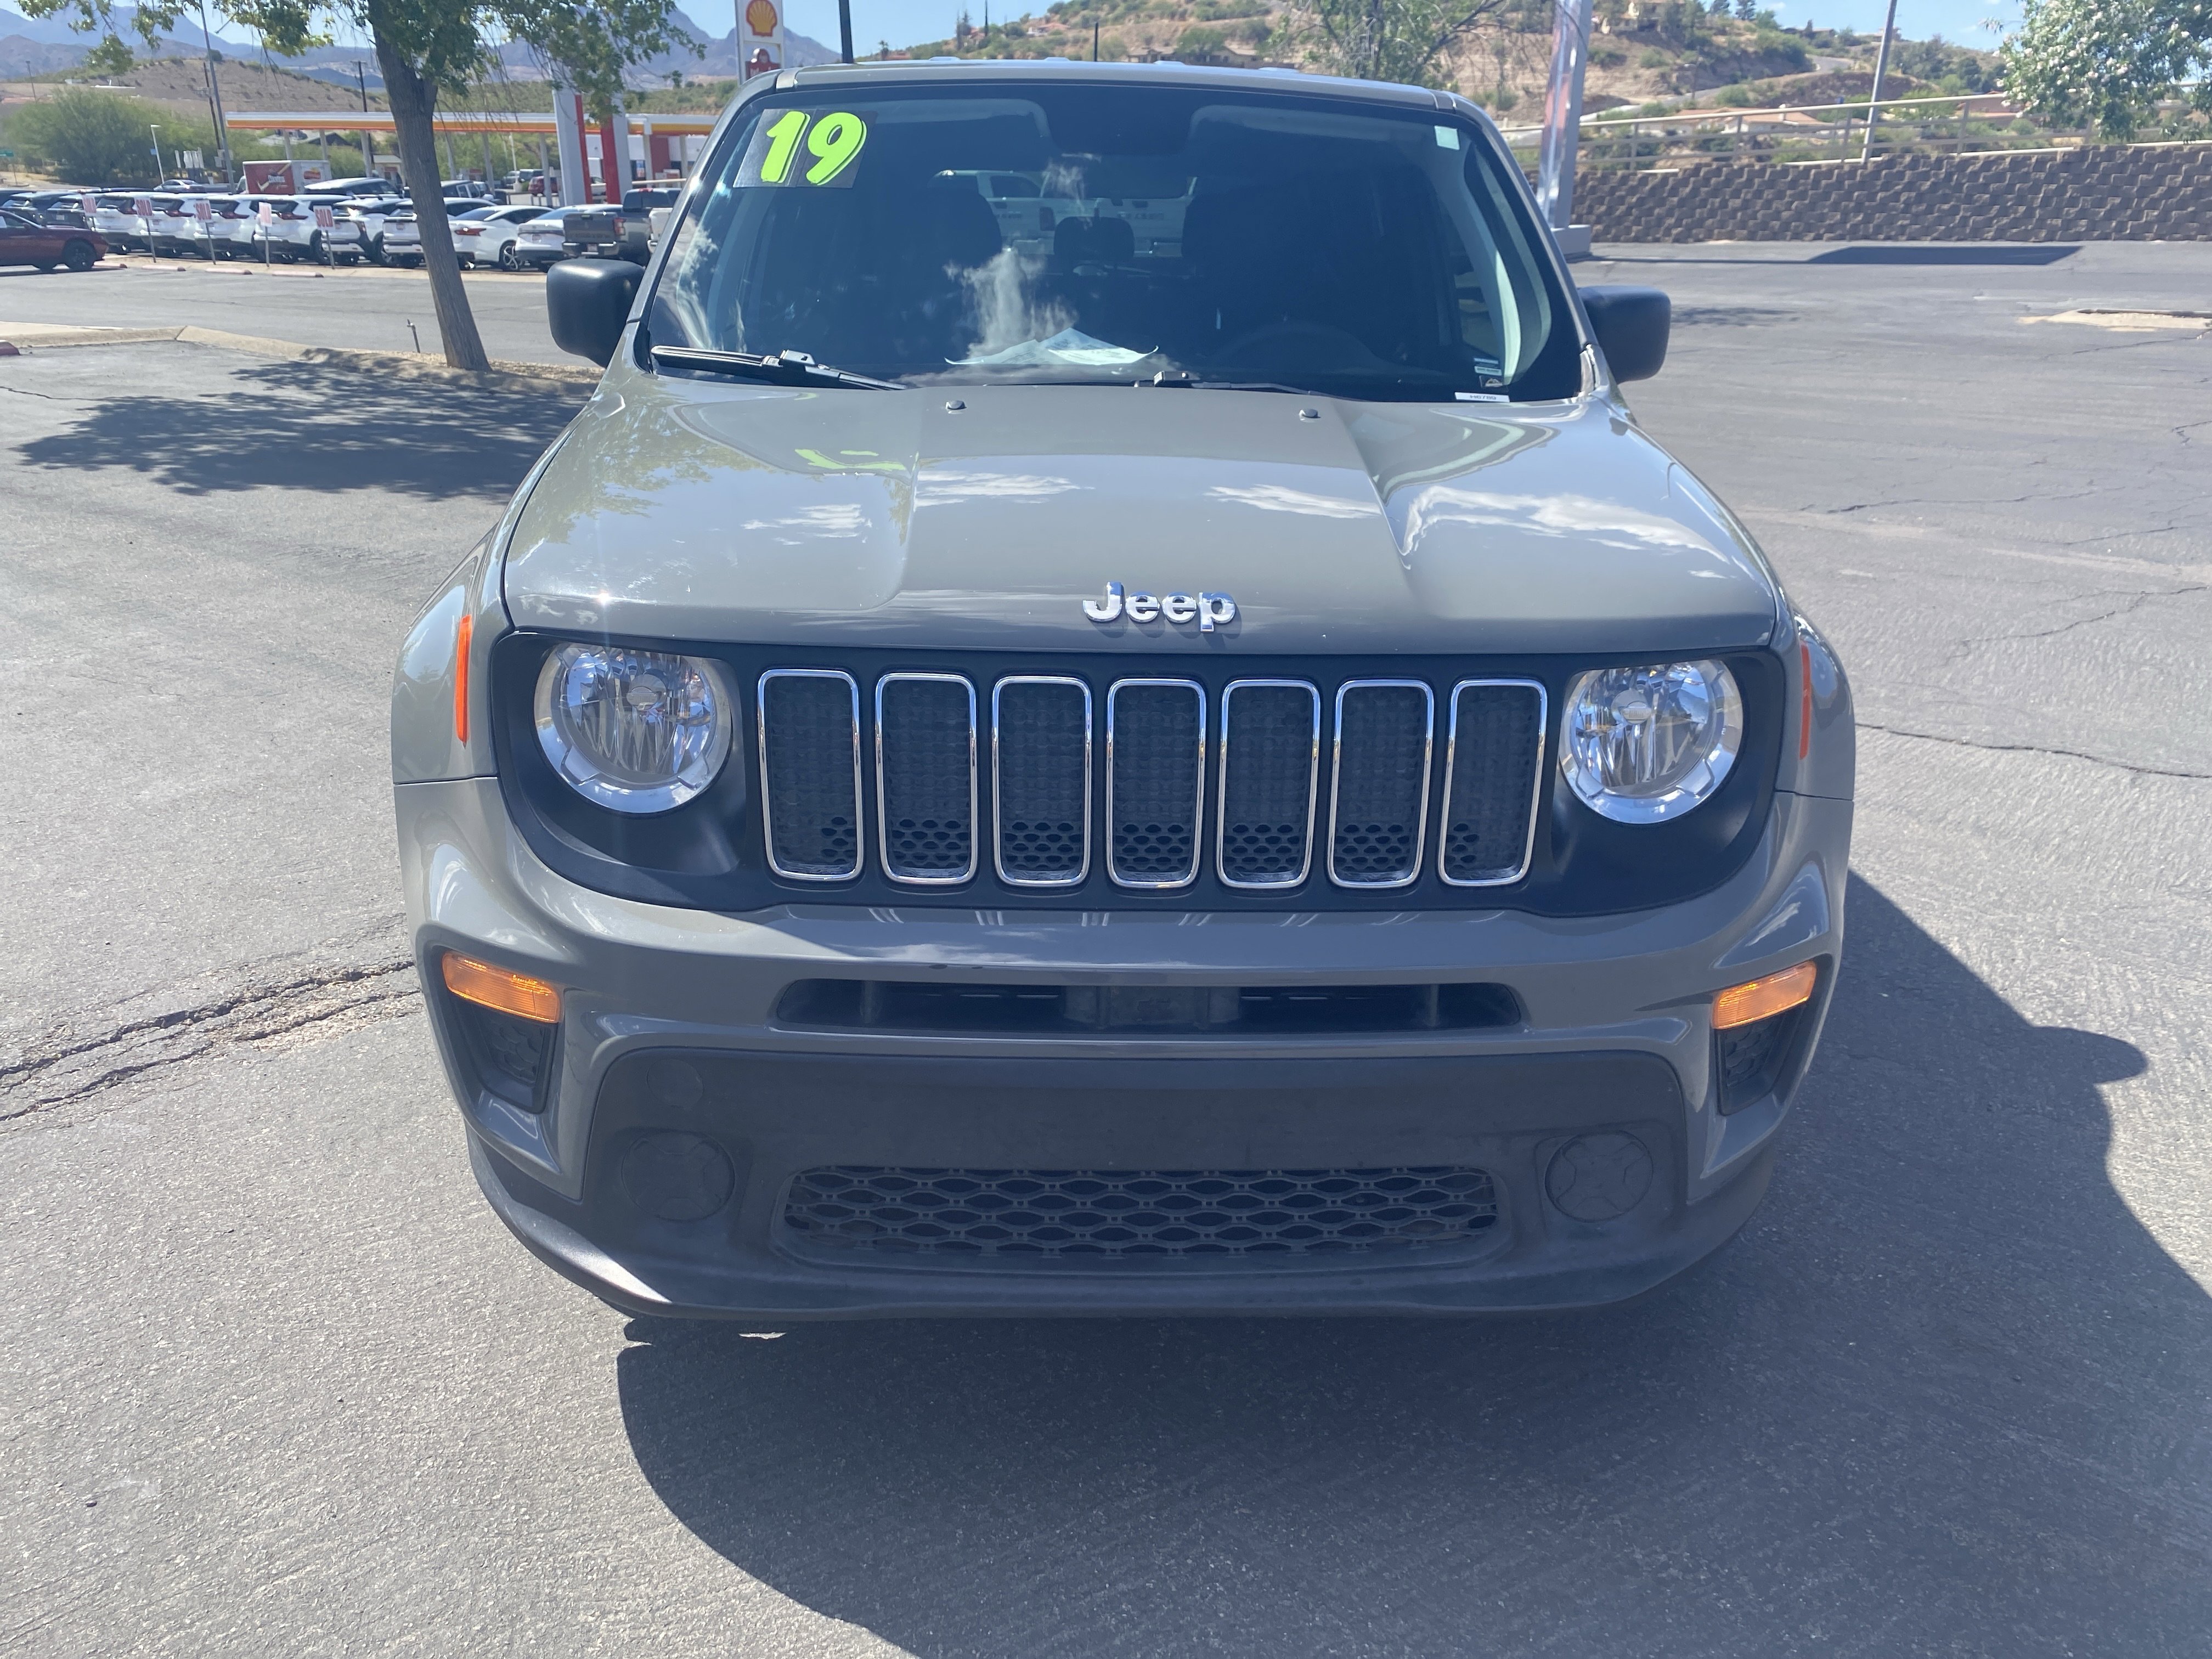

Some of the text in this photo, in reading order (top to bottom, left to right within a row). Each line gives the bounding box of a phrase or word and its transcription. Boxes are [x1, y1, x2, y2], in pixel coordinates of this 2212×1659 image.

[761, 111, 867, 185] 19
[196, 203, 212, 220] SOLD
[315, 208, 333, 227] SOLD
[1083, 582, 1236, 632] Jeep
